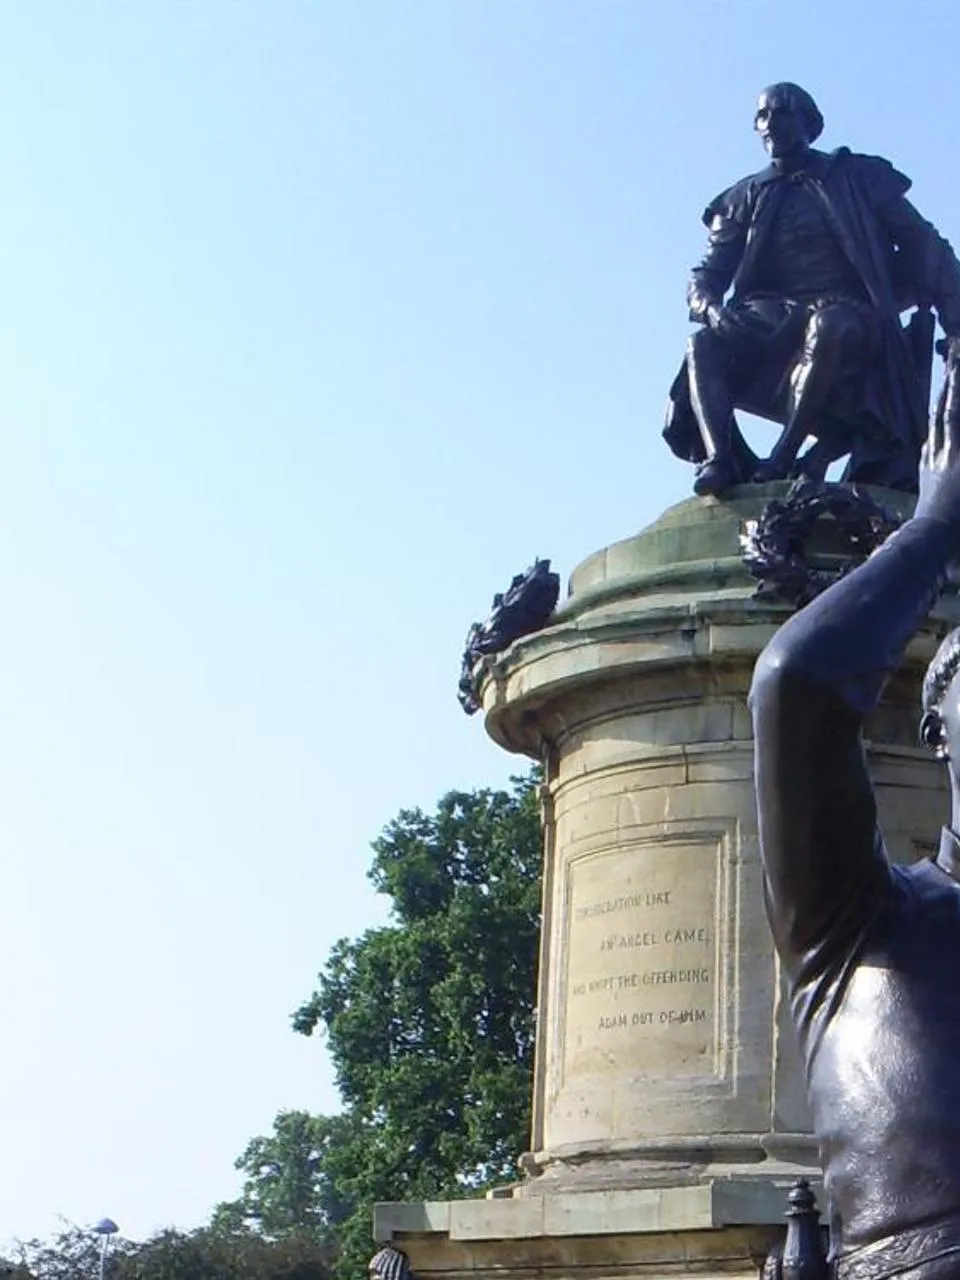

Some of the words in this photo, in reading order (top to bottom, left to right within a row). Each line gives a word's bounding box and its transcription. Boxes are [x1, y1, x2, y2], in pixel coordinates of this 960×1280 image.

[621, 932, 657, 948] ANGEL
[616, 974, 636, 989] THE
[643, 968, 709, 985] OFFENDING
[599, 1010, 627, 1029] ADAM
[632, 1011, 653, 1026] OUT
[660, 1009, 673, 1024] OF
